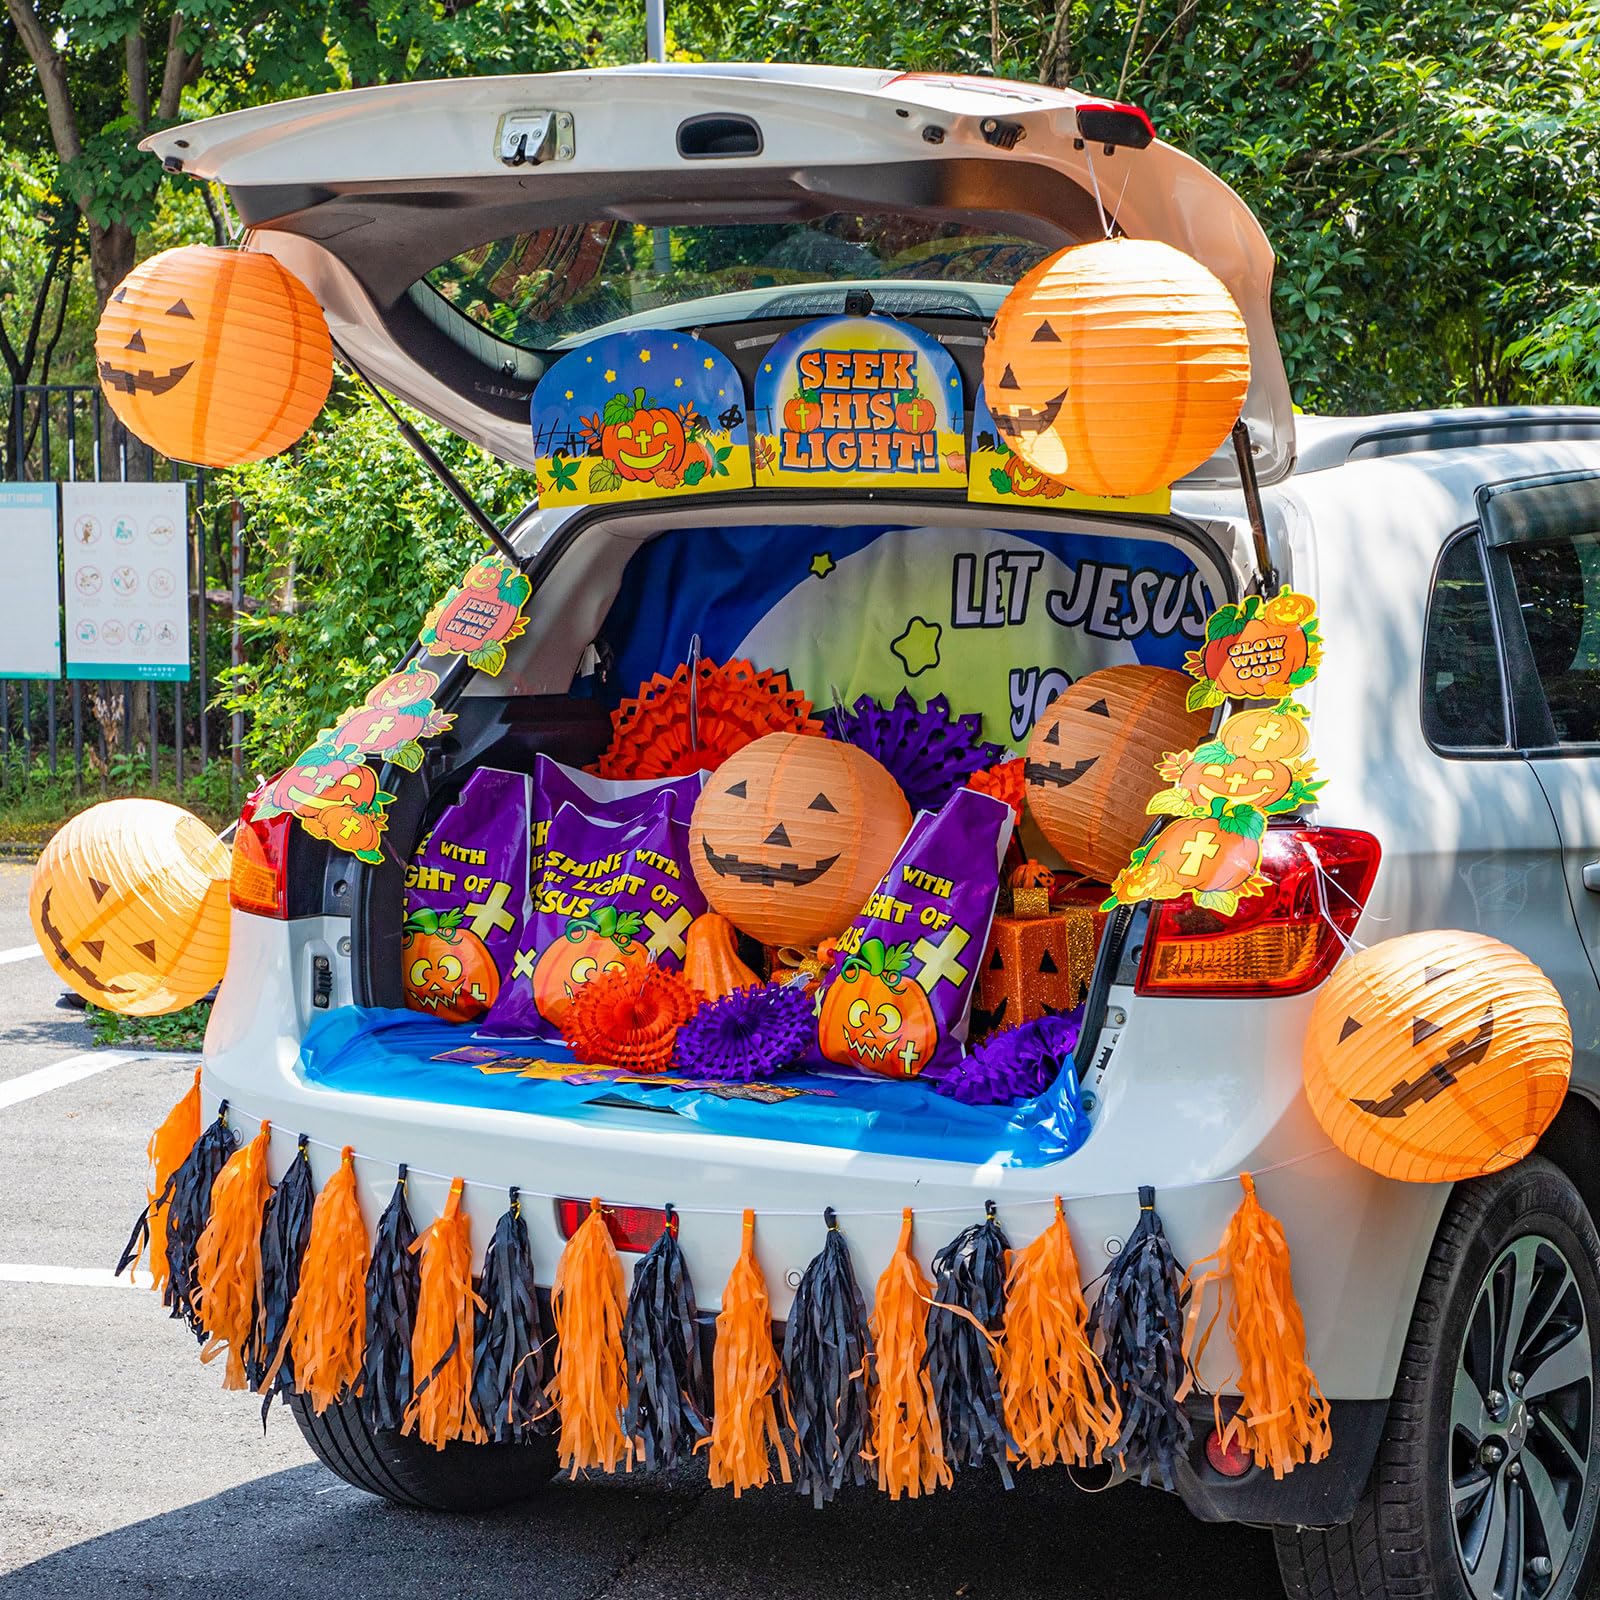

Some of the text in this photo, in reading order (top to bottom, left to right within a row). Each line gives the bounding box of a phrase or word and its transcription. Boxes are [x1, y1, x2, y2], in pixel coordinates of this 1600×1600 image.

[800, 352, 914, 390] SEEK
[821, 392, 895, 430] HIS
[782, 432, 937, 469] LIGHT!
[462, 598, 503, 617] JESUS
[953, 551, 1208, 638] LET JESUS
[446, 620, 488, 640] IN ME
[454, 609, 497, 628] SHINE
[1228, 636, 1287, 656] GLOW
[1231, 650, 1285, 668] WITH
[1237, 663, 1281, 680] GOD
[440, 841, 486, 865] WITH
[545, 850, 628, 878] SHINE
[635, 849, 681, 880] WITH
[404, 865, 492, 893] GHT OF
[543, 871, 680, 908] HE LIGHT OF
[903, 865, 954, 898] WITH
[539, 889, 595, 919] SUS
[920, 907, 952, 931] OF
